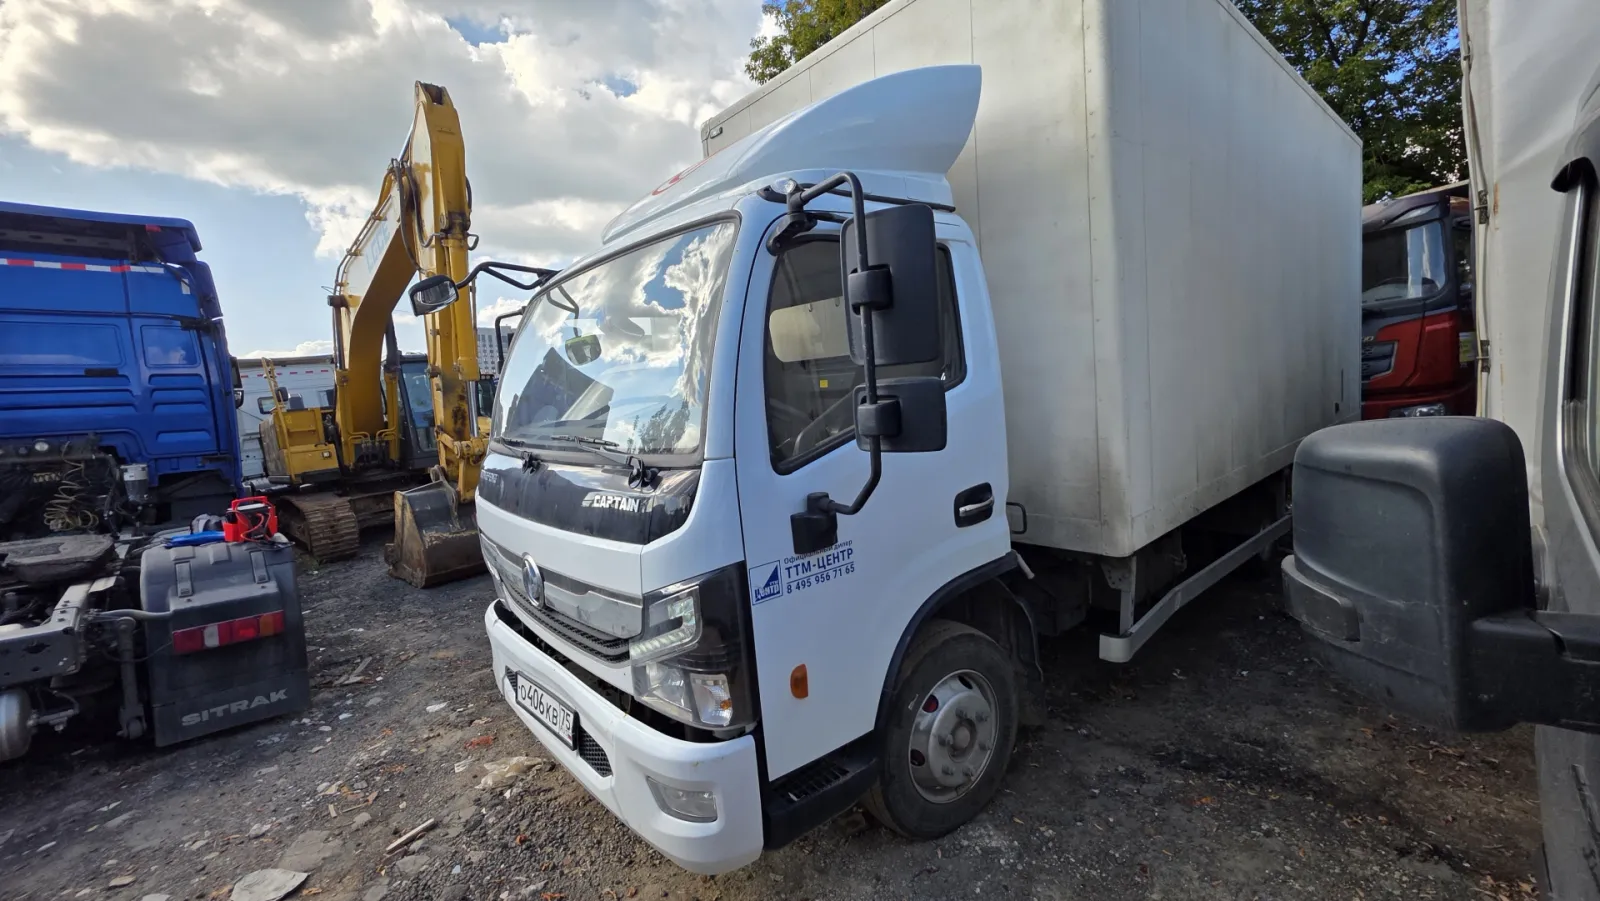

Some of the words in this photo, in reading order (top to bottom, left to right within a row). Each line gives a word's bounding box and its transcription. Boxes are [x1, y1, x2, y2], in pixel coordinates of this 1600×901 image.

[593, 494, 640, 513] CAPTAIN
[785, 548, 853, 579] ТТМ-ЦЕНТР
[787, 585, 793, 595] 8
[796, 578, 812, 591] 495
[815, 573, 831, 585] 956
[833, 568, 843, 579] 71
[845, 564, 855, 574] 65
[181, 688, 288, 727] SITRAK
